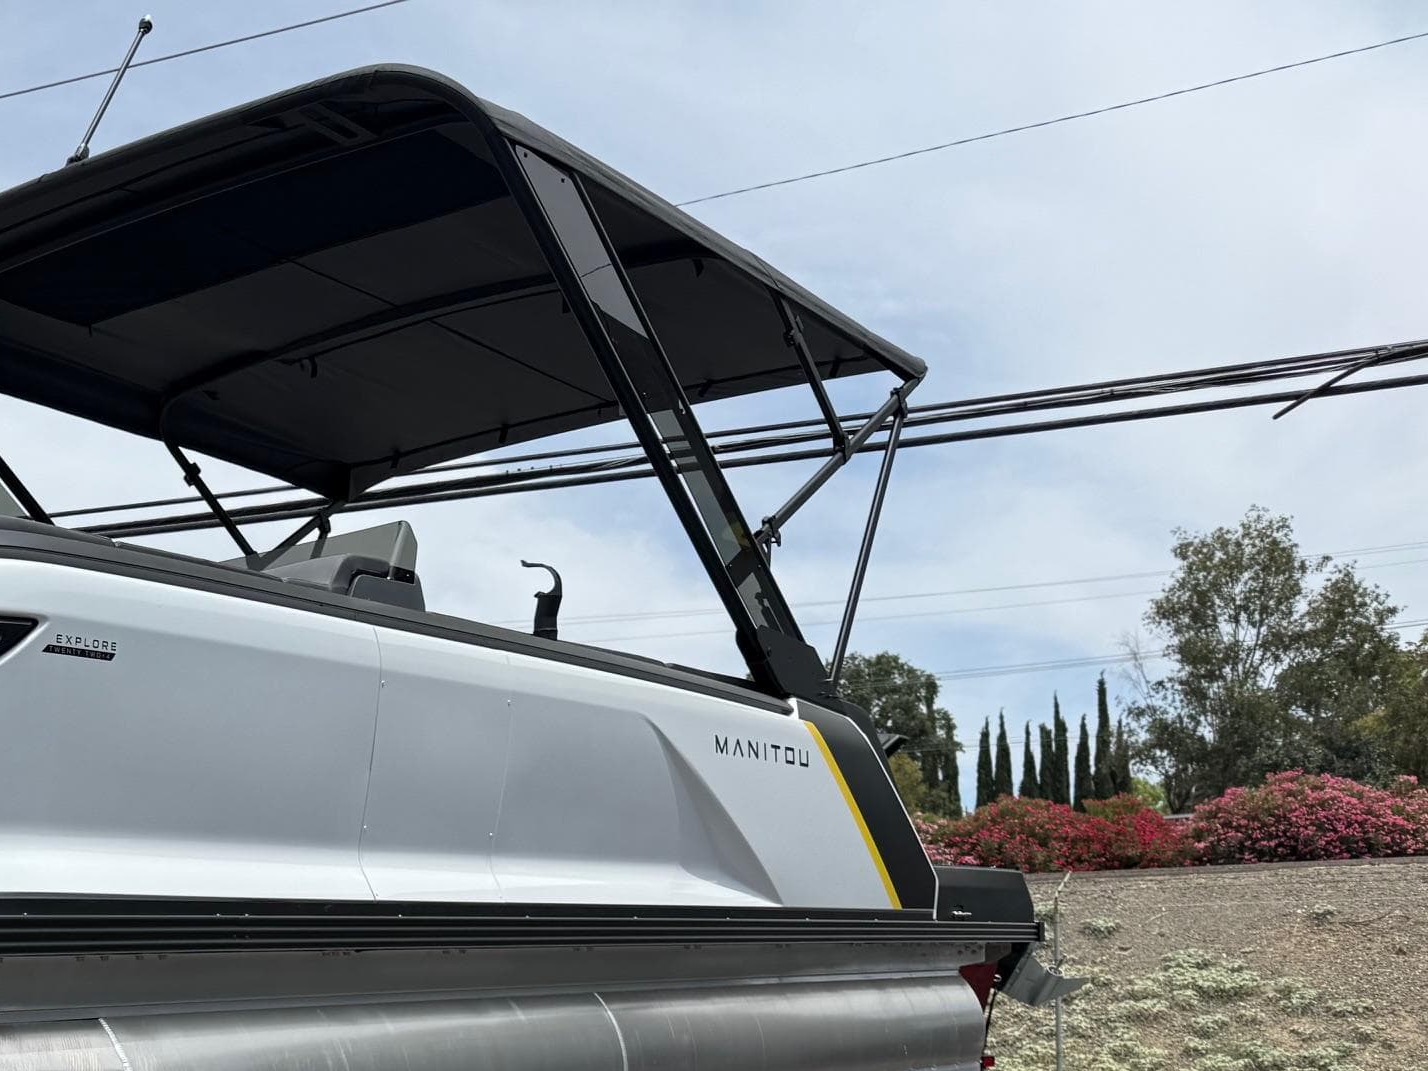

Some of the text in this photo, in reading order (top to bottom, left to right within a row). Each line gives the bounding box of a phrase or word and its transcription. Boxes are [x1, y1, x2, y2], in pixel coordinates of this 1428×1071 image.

[48, 645, 82, 656] TWENTY
[56, 634, 117, 651] EXPLORE
[714, 734, 809, 768] MANITOU
